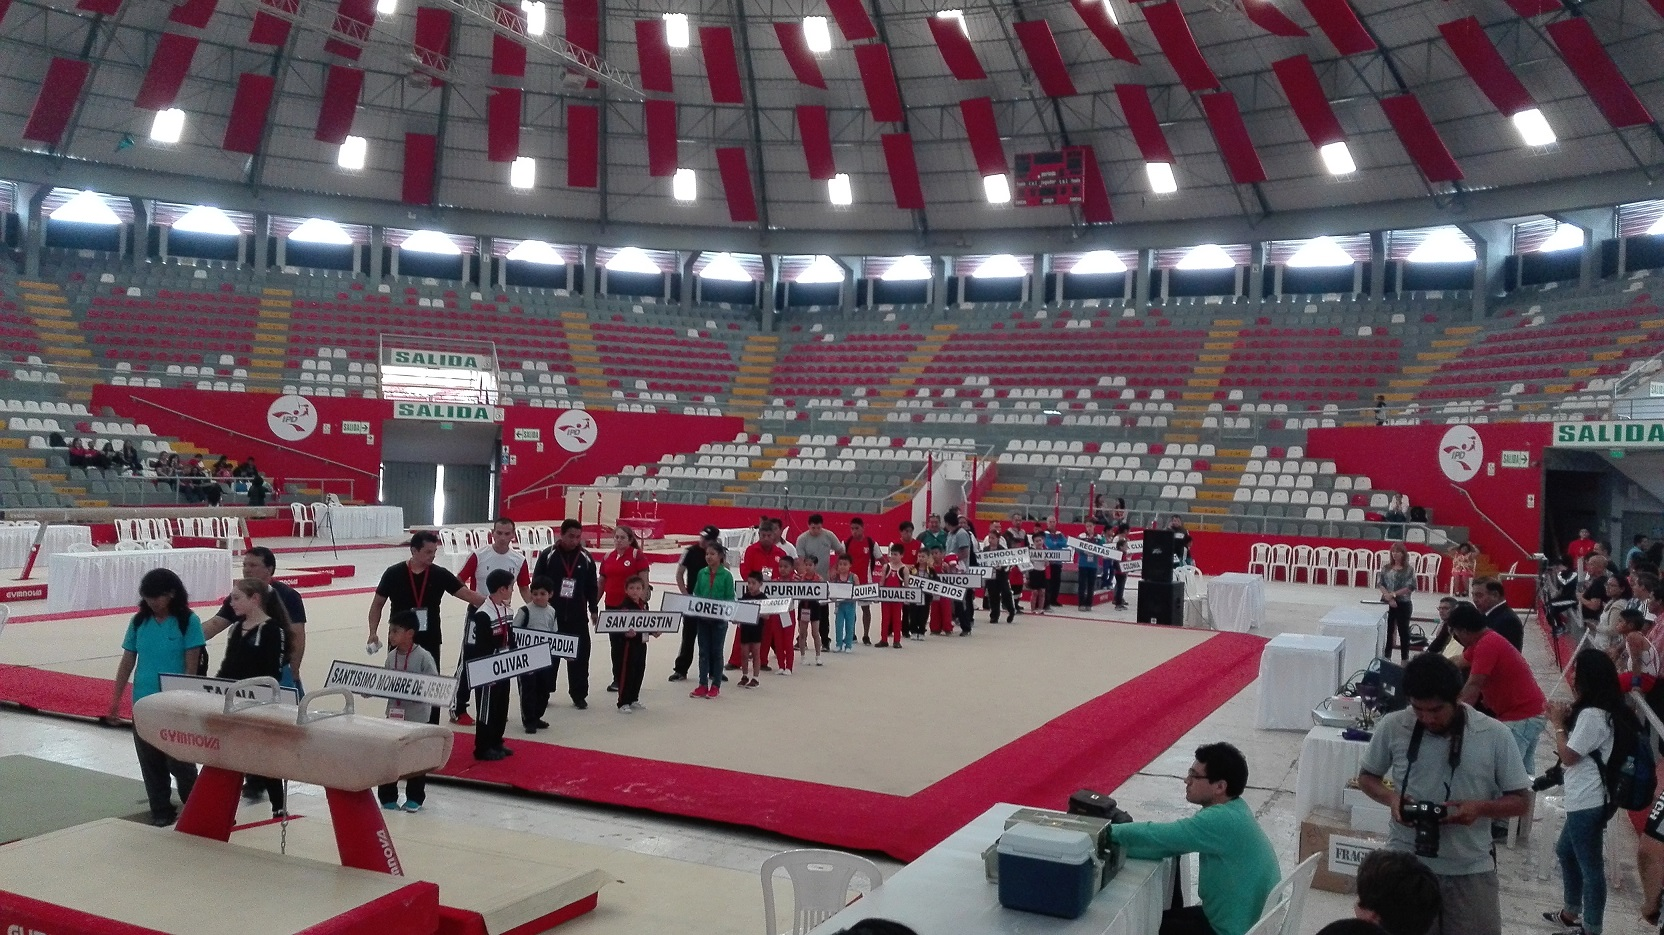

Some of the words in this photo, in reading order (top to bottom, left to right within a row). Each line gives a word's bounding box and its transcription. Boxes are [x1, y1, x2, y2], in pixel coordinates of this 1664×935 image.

[395, 351, 477, 368] SALIDA
[399, 403, 489, 419] SALIDA
[282, 415, 298, 423] IPD
[343, 423, 360, 432] SALIDA
[1558, 424, 1664, 442] SALIDA
[1451, 451, 1466, 460] IPD
[1503, 453, 1519, 464] SALIDA
[984, 550, 1015, 560] SCHOOL
[1017, 548, 1028, 556] OF
[1044, 551, 1061, 559] XXIII
[1079, 542, 1110, 556] REGATAS
[990, 557, 1023, 567] AMAZON
[763, 585, 821, 596] APURIMAC
[853, 585, 877, 597] QUIPA
[927, 581, 939, 593] DE
[941, 586, 963, 598] DIOS
[687, 600, 734, 617] LORETO
[605, 615, 627, 628] SAN
[628, 615, 673, 628] AGUSTIN
[547, 637, 574, 654] PADUA
[492, 653, 529, 676] OLIVAR
[331, 667, 377, 690] SANTISIMO
[378, 676, 409, 694] MONBRE
[410, 682, 423, 696] DE
[424, 683, 452, 699] JESUS
[1335, 847, 1368, 863] FRAG
